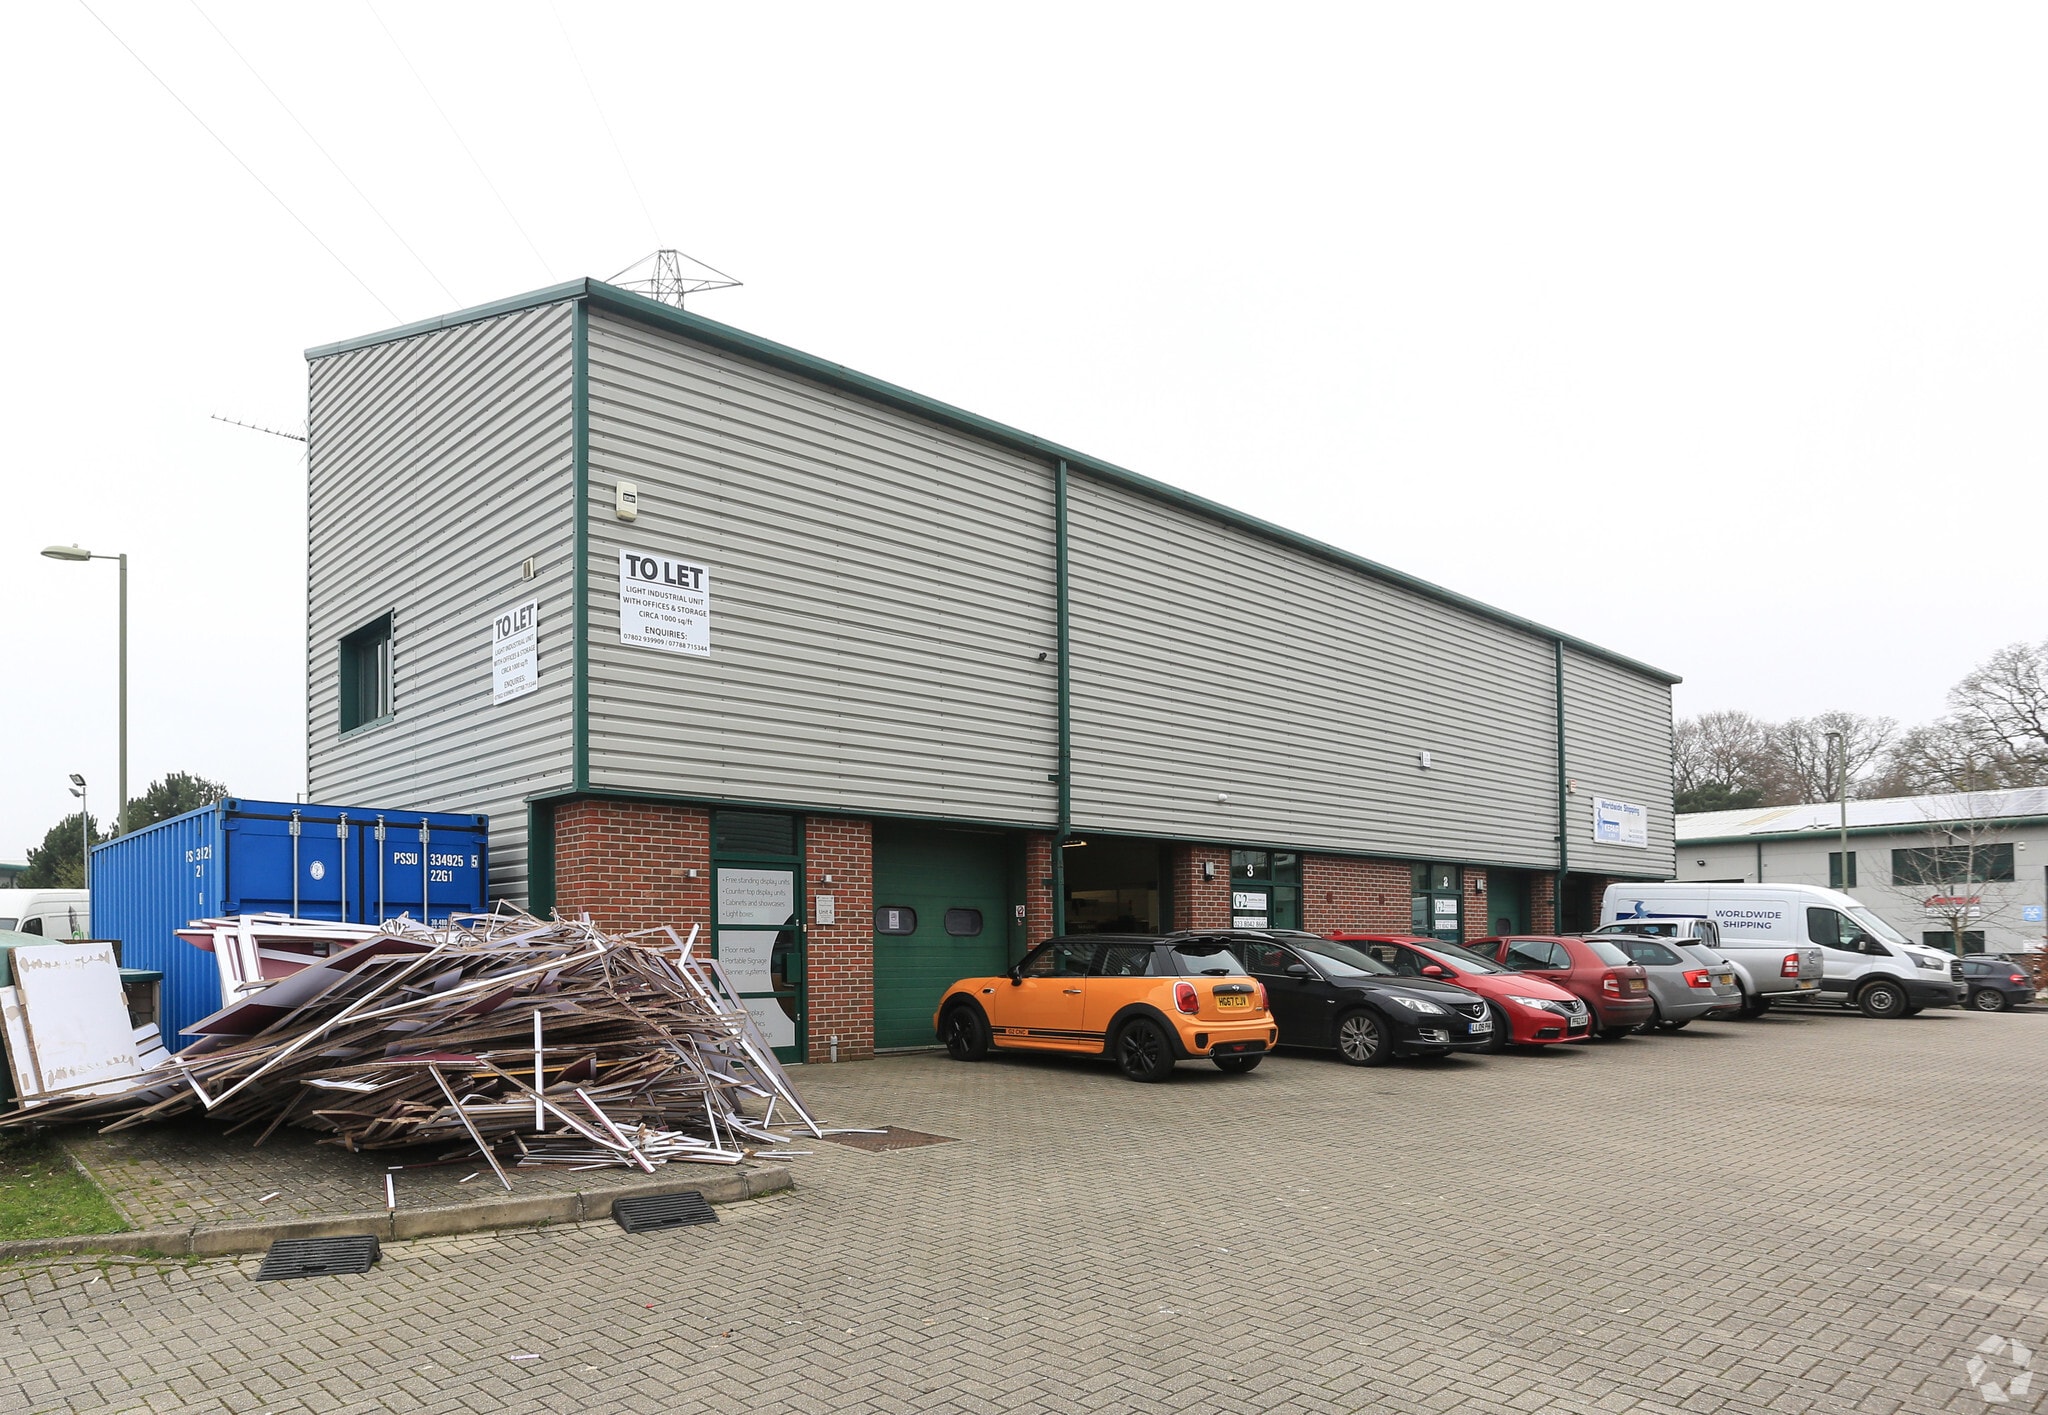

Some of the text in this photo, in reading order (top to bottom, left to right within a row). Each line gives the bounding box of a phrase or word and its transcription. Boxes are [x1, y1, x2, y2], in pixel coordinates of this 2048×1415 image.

[626, 554, 703, 589] TO LET
[626, 586, 704, 606] LIGHT INDUSTRIAL UNIT
[622, 596, 642, 605] WITH
[642, 600, 670, 610] OFFICES
[677, 606, 708, 617] STORAGE
[496, 603, 534, 640] TO LET
[638, 610, 659, 620] CIRCA
[661, 614, 676, 623] 1000
[645, 626, 688, 640] ENQUIRIES:
[394, 852, 478, 868] PSSU 334925 5
[430, 870, 452, 882] 22G1
[1247, 864, 1254, 877] 3
[739, 877, 759, 886] standing
[1443, 876, 1448, 887] 2
[1234, 894, 1247, 908] G2
[1715, 910, 1782, 919] WORLDWIDE
[1723, 920, 1772, 929] SHIPPING
